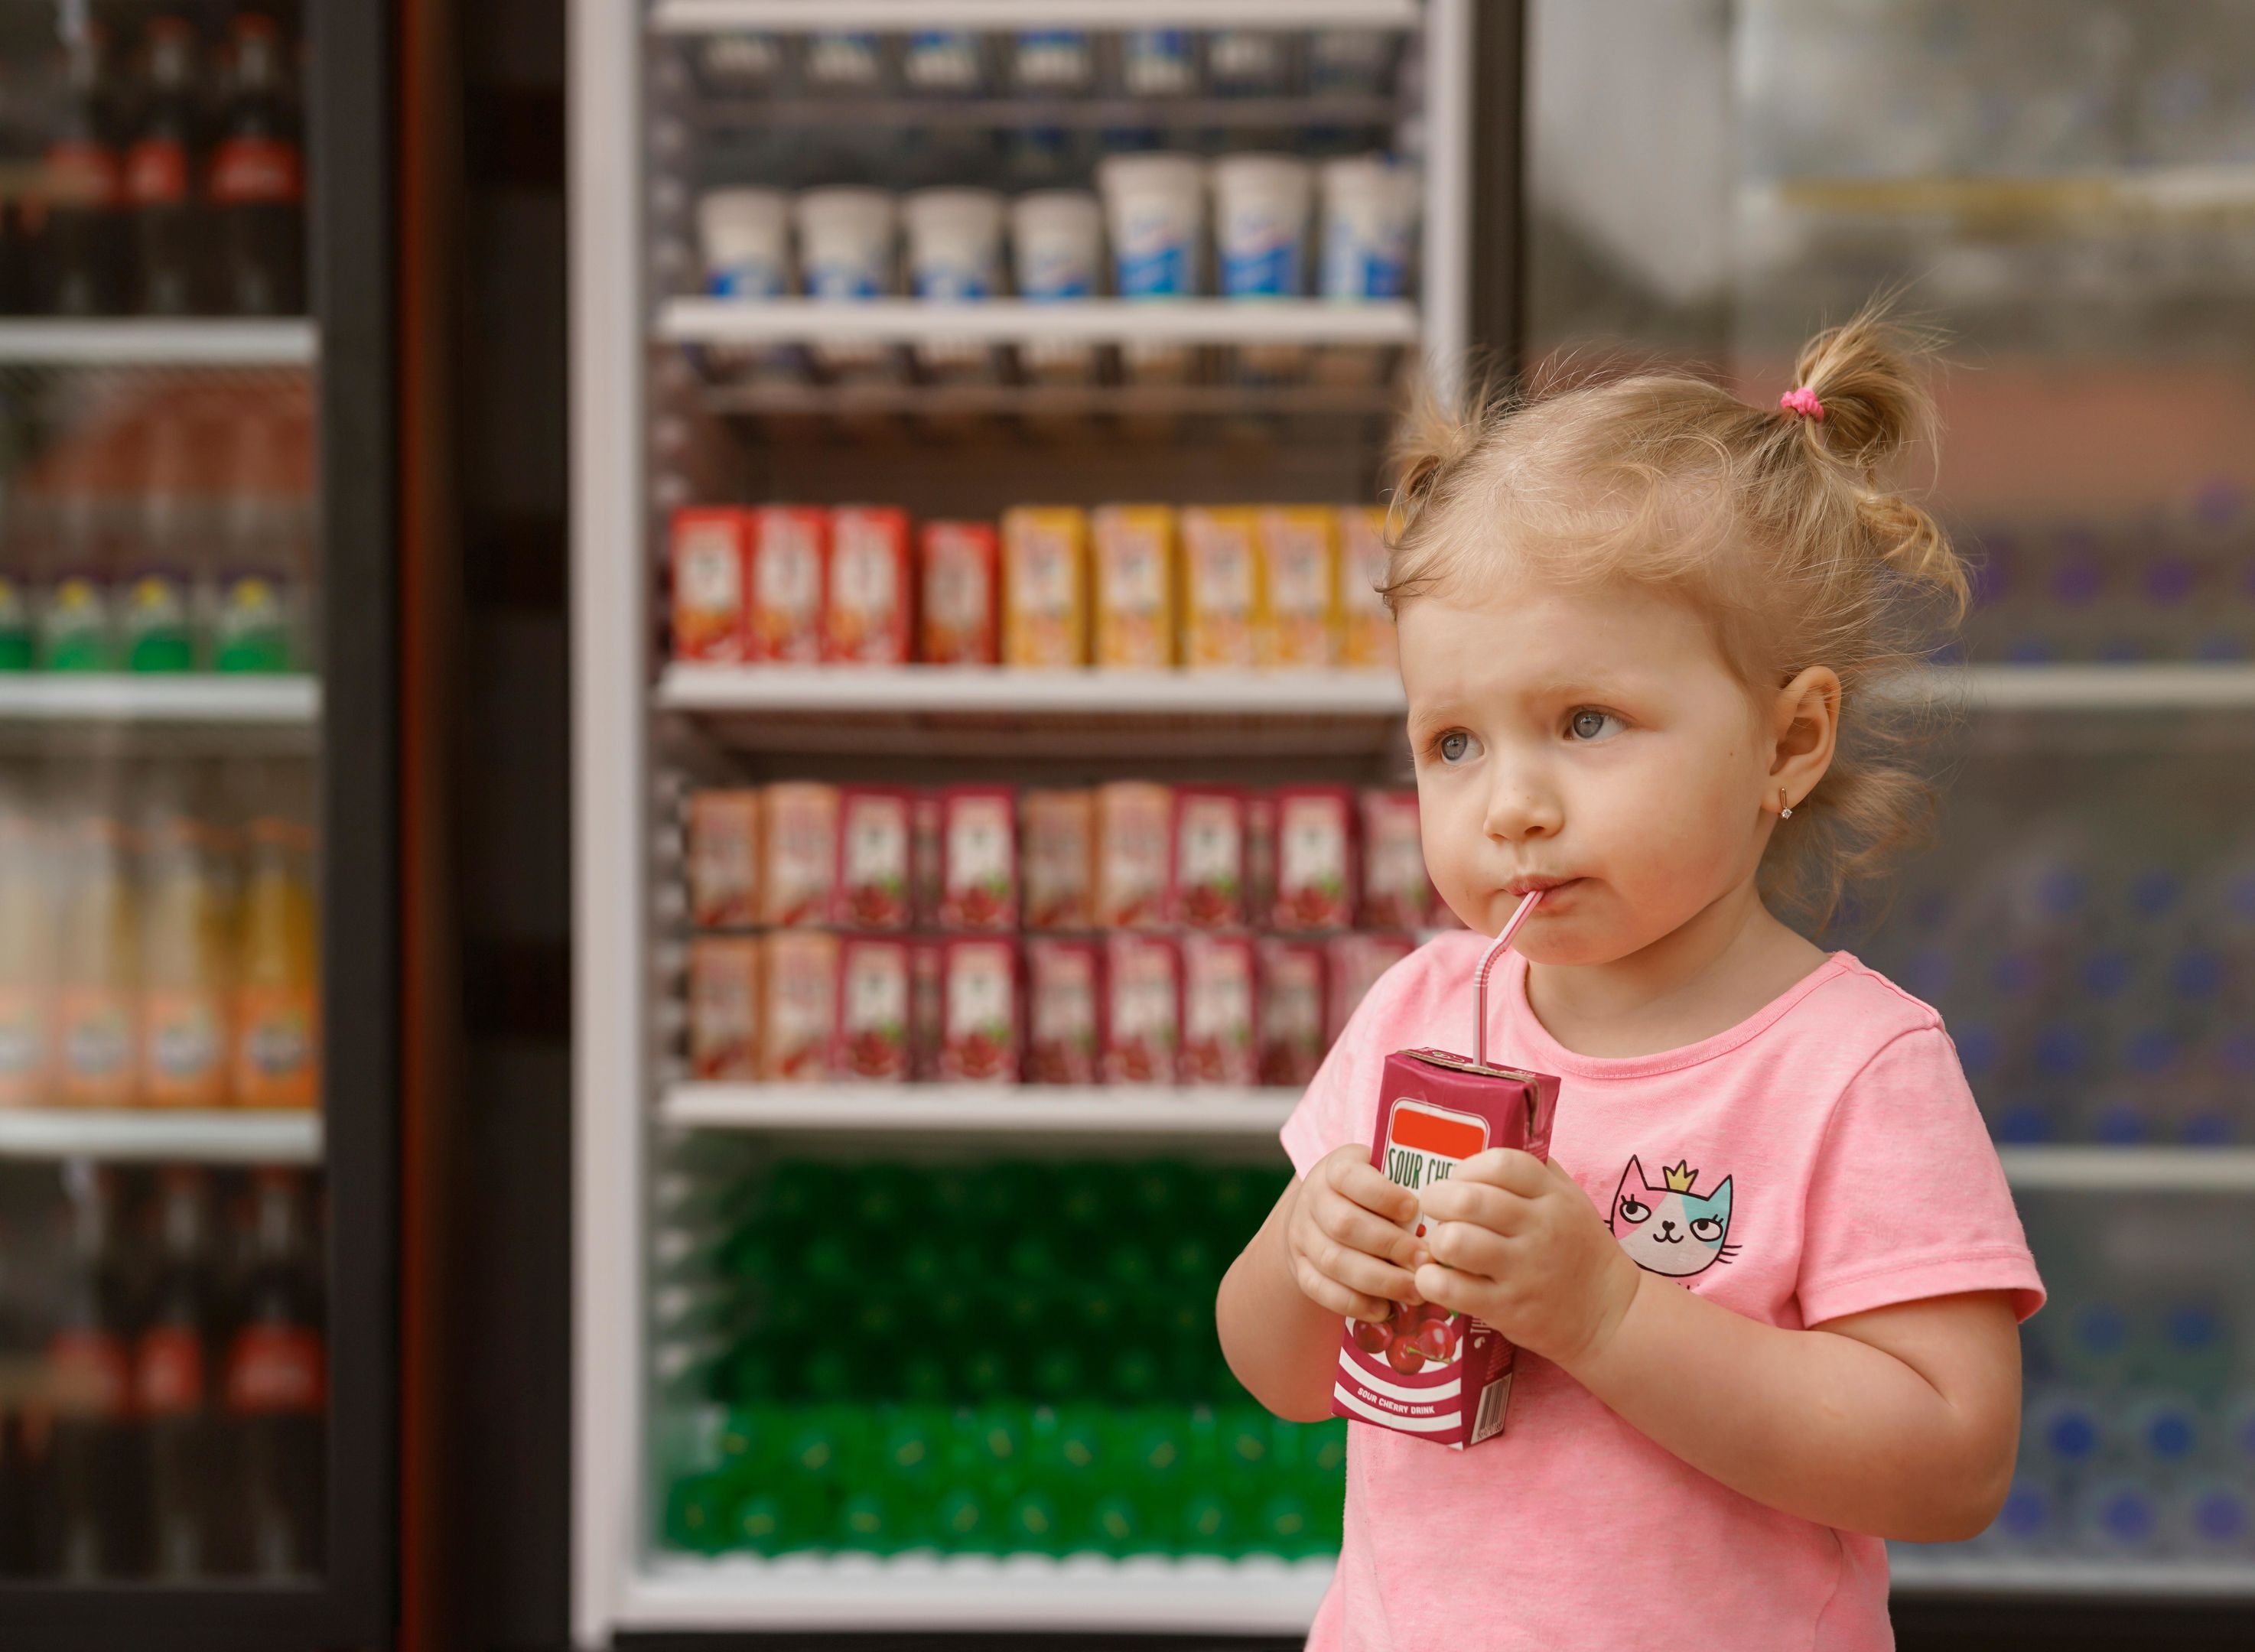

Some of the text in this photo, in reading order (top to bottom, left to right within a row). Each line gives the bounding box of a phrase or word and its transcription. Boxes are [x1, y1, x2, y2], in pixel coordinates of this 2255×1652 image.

[1388, 1148, 1423, 1189] SOUR
[1358, 1387, 1435, 1415] SOUR CHERRY DRINK
